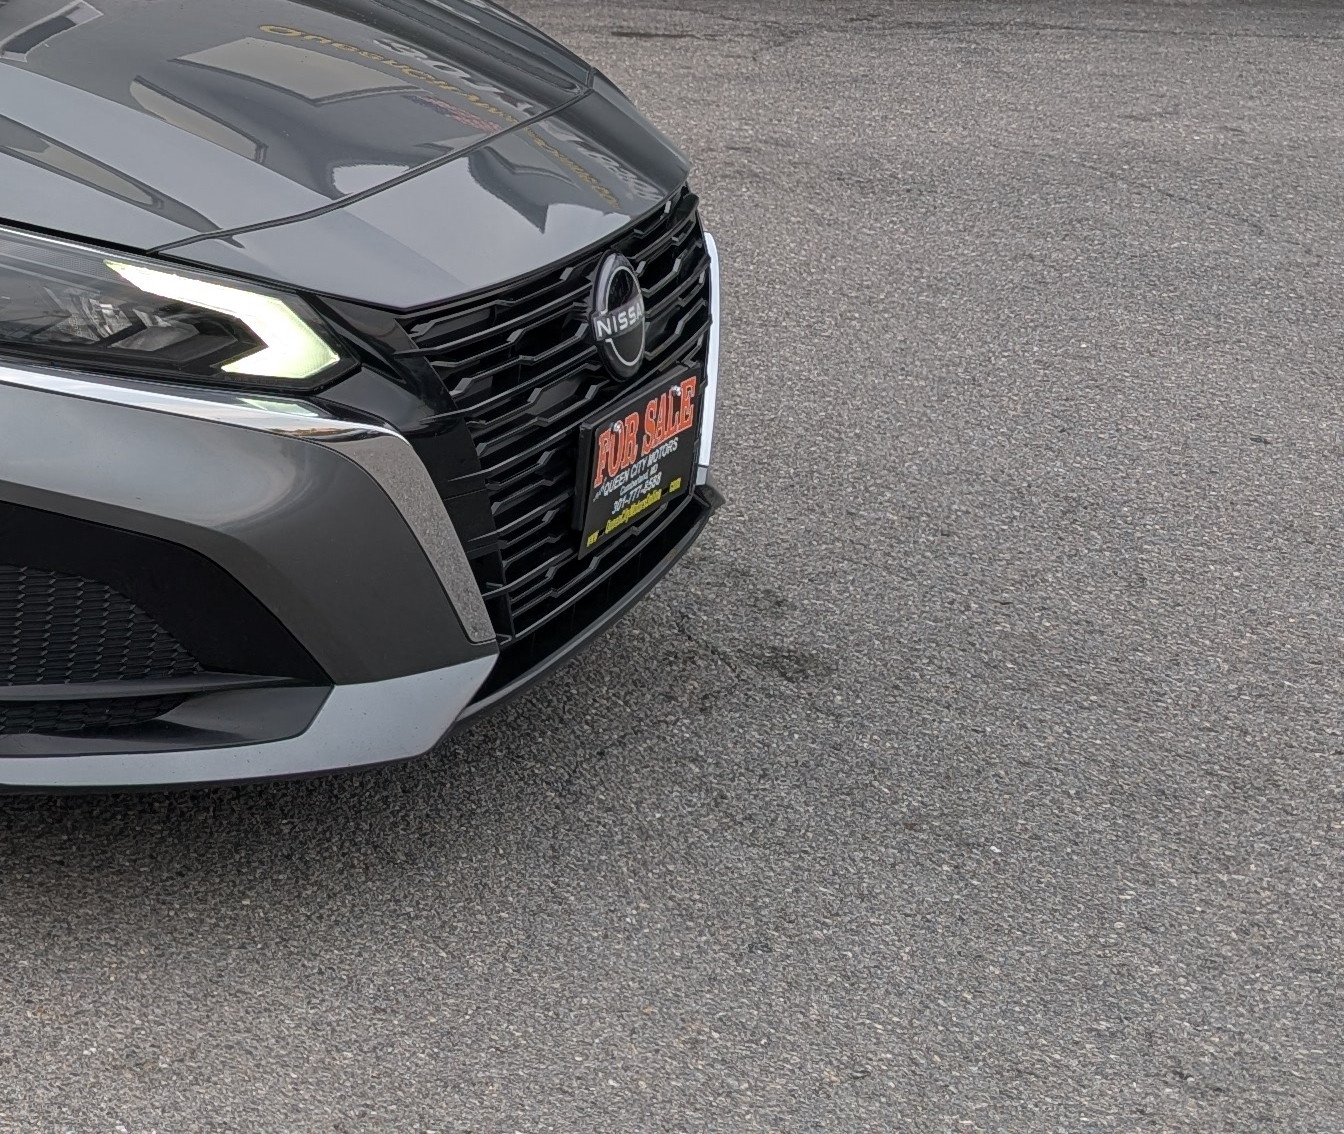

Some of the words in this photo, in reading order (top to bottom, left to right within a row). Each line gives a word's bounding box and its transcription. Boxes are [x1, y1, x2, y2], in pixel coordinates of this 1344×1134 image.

[596, 299, 644, 337] NISSA
[593, 411, 640, 489] FOR
[641, 376, 698, 456] SALE
[603, 468, 630, 496] QUEEN
[631, 456, 648, 478] CITY
